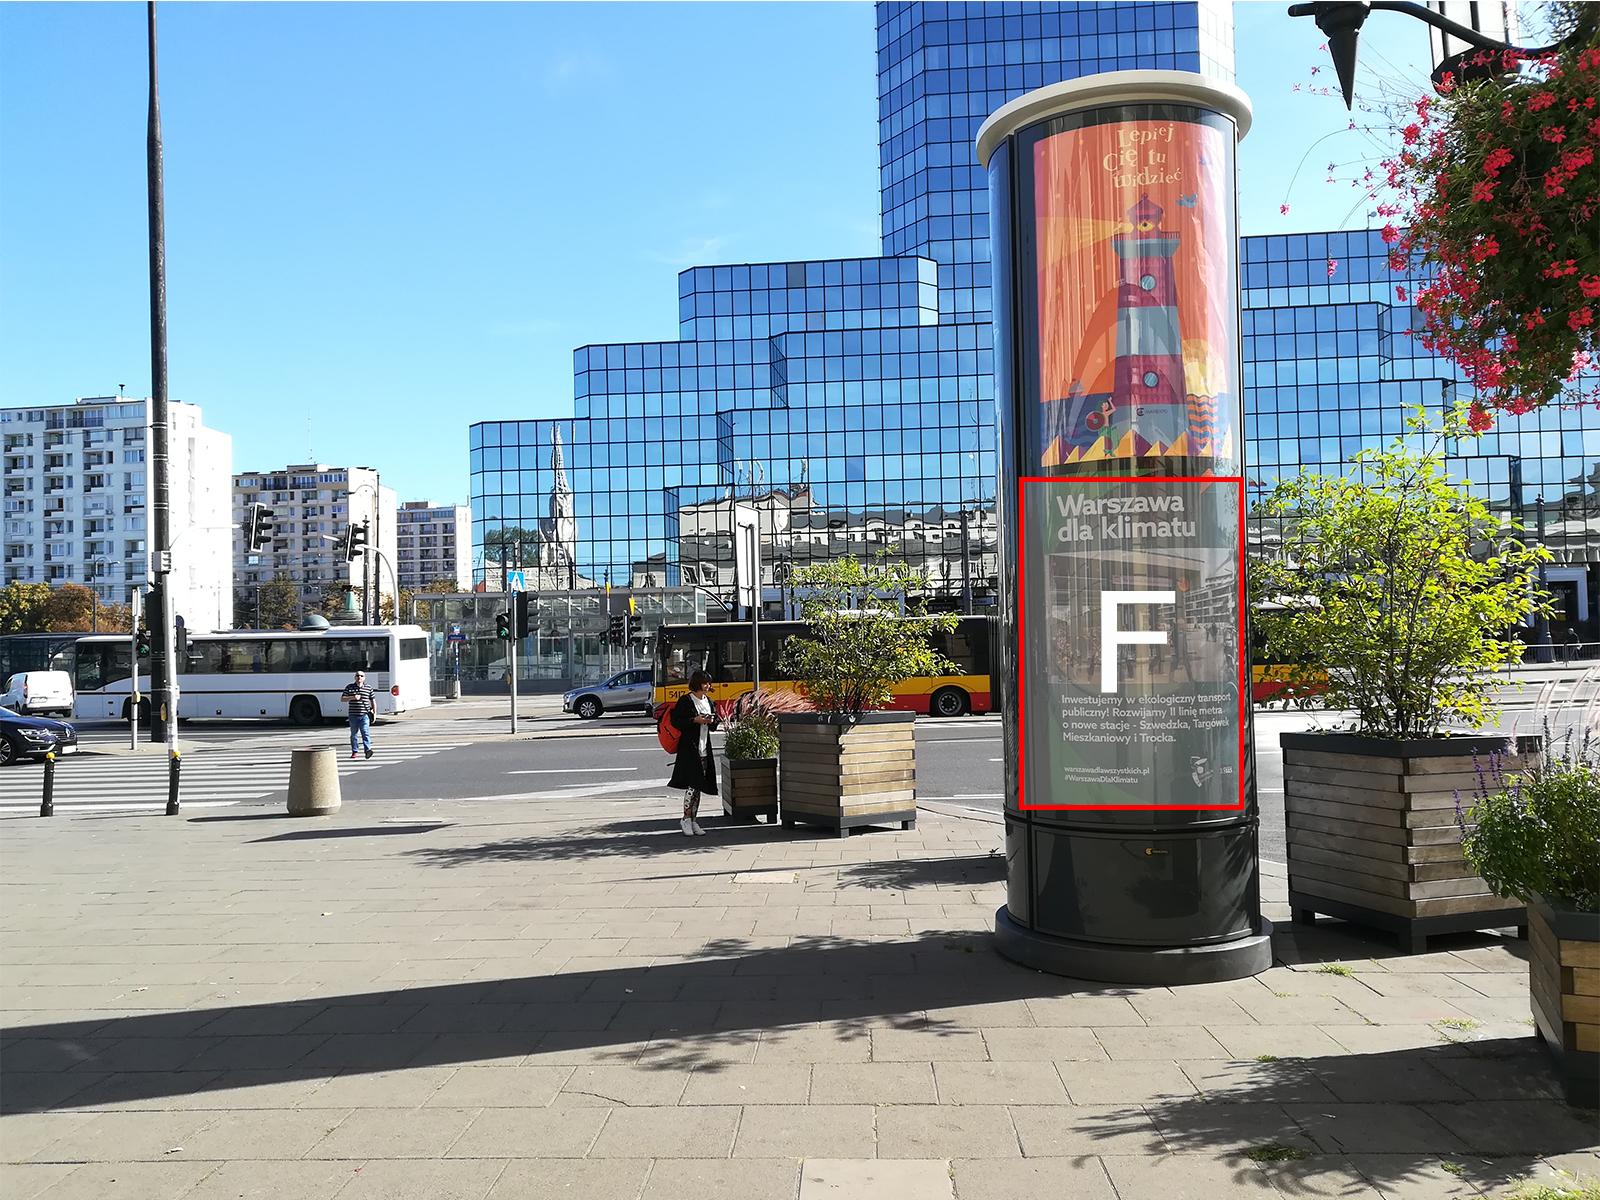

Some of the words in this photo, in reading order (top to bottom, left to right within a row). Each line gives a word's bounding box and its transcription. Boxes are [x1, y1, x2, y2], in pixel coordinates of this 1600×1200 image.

[1118, 123, 1174, 148] Lepiej
[1103, 148, 1137, 171] Cię
[1148, 148, 1166, 165] tu
[1056, 493, 1185, 517] Warszawa
[1057, 518, 1094, 542] dla
[1101, 515, 1196, 540] klimatu
[1061, 694, 1123, 707] Inwestujemy
[1126, 697, 1136, 705] w
[1138, 693, 1196, 706] ekologiczny
[1197, 692, 1232, 704] transport
[1062, 707, 1110, 719] publiczny!
[1112, 707, 1167, 719] Rozwijamy
[1178, 706, 1198, 718] linię
[1199, 706, 1223, 715] metra
[1071, 721, 1098, 730] nowe
[1100, 720, 1130, 732] stacje
[1139, 719, 1191, 731] Szwedzka,
[1193, 717, 1229, 730] Targówek
[1063, 732, 1131, 745] Mieszkaniowy
[1133, 733, 1138, 743] i
[1139, 732, 1177, 743] Trocka.
[1063, 766, 1150, 776] warszawadlawszystkich.pl
[1064, 774, 1139, 784] #WarszawaDlaKlimatu
